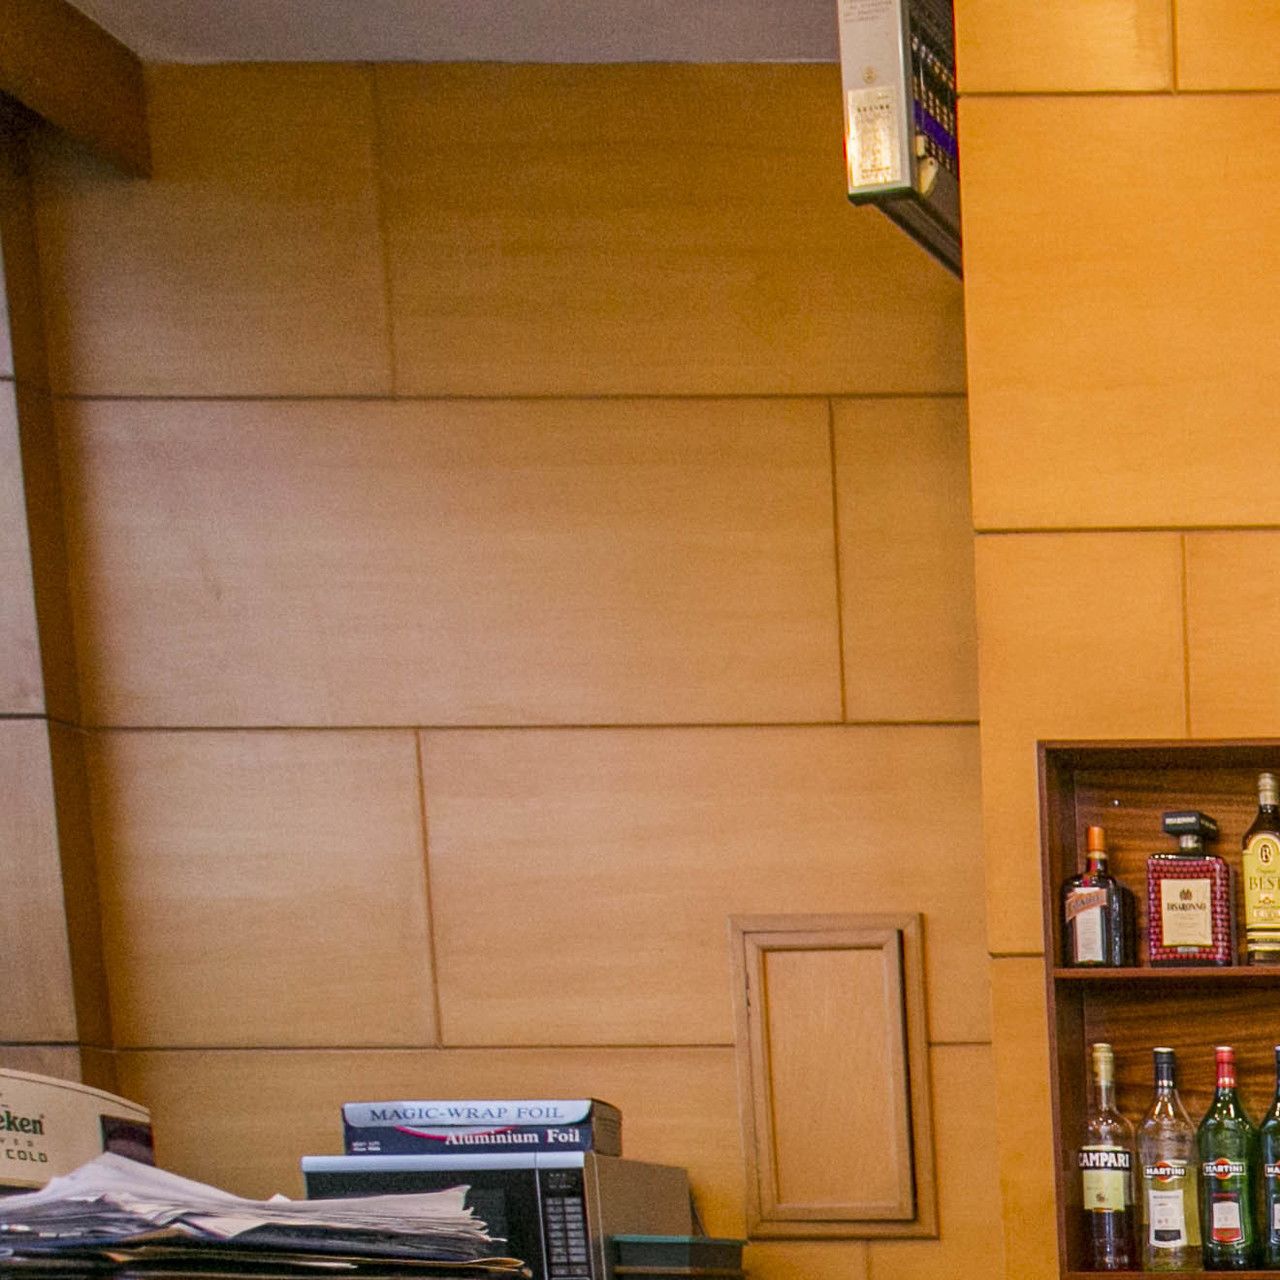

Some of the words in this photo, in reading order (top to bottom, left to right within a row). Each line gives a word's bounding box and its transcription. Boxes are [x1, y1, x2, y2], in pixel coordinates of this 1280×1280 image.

[371, 1107, 508, 1121] MAGIC-WRAP
[517, 1107, 565, 1119] FOIL
[445, 1130, 539, 1146] Aluminium
[547, 1128, 580, 1143] Foil
[6, 1149, 48, 1163] COLD
[1079, 1152, 1130, 1168] CAMPARI
[1145, 1167, 1185, 1175] MARTINI
[1205, 1165, 1243, 1173] MARTINI
